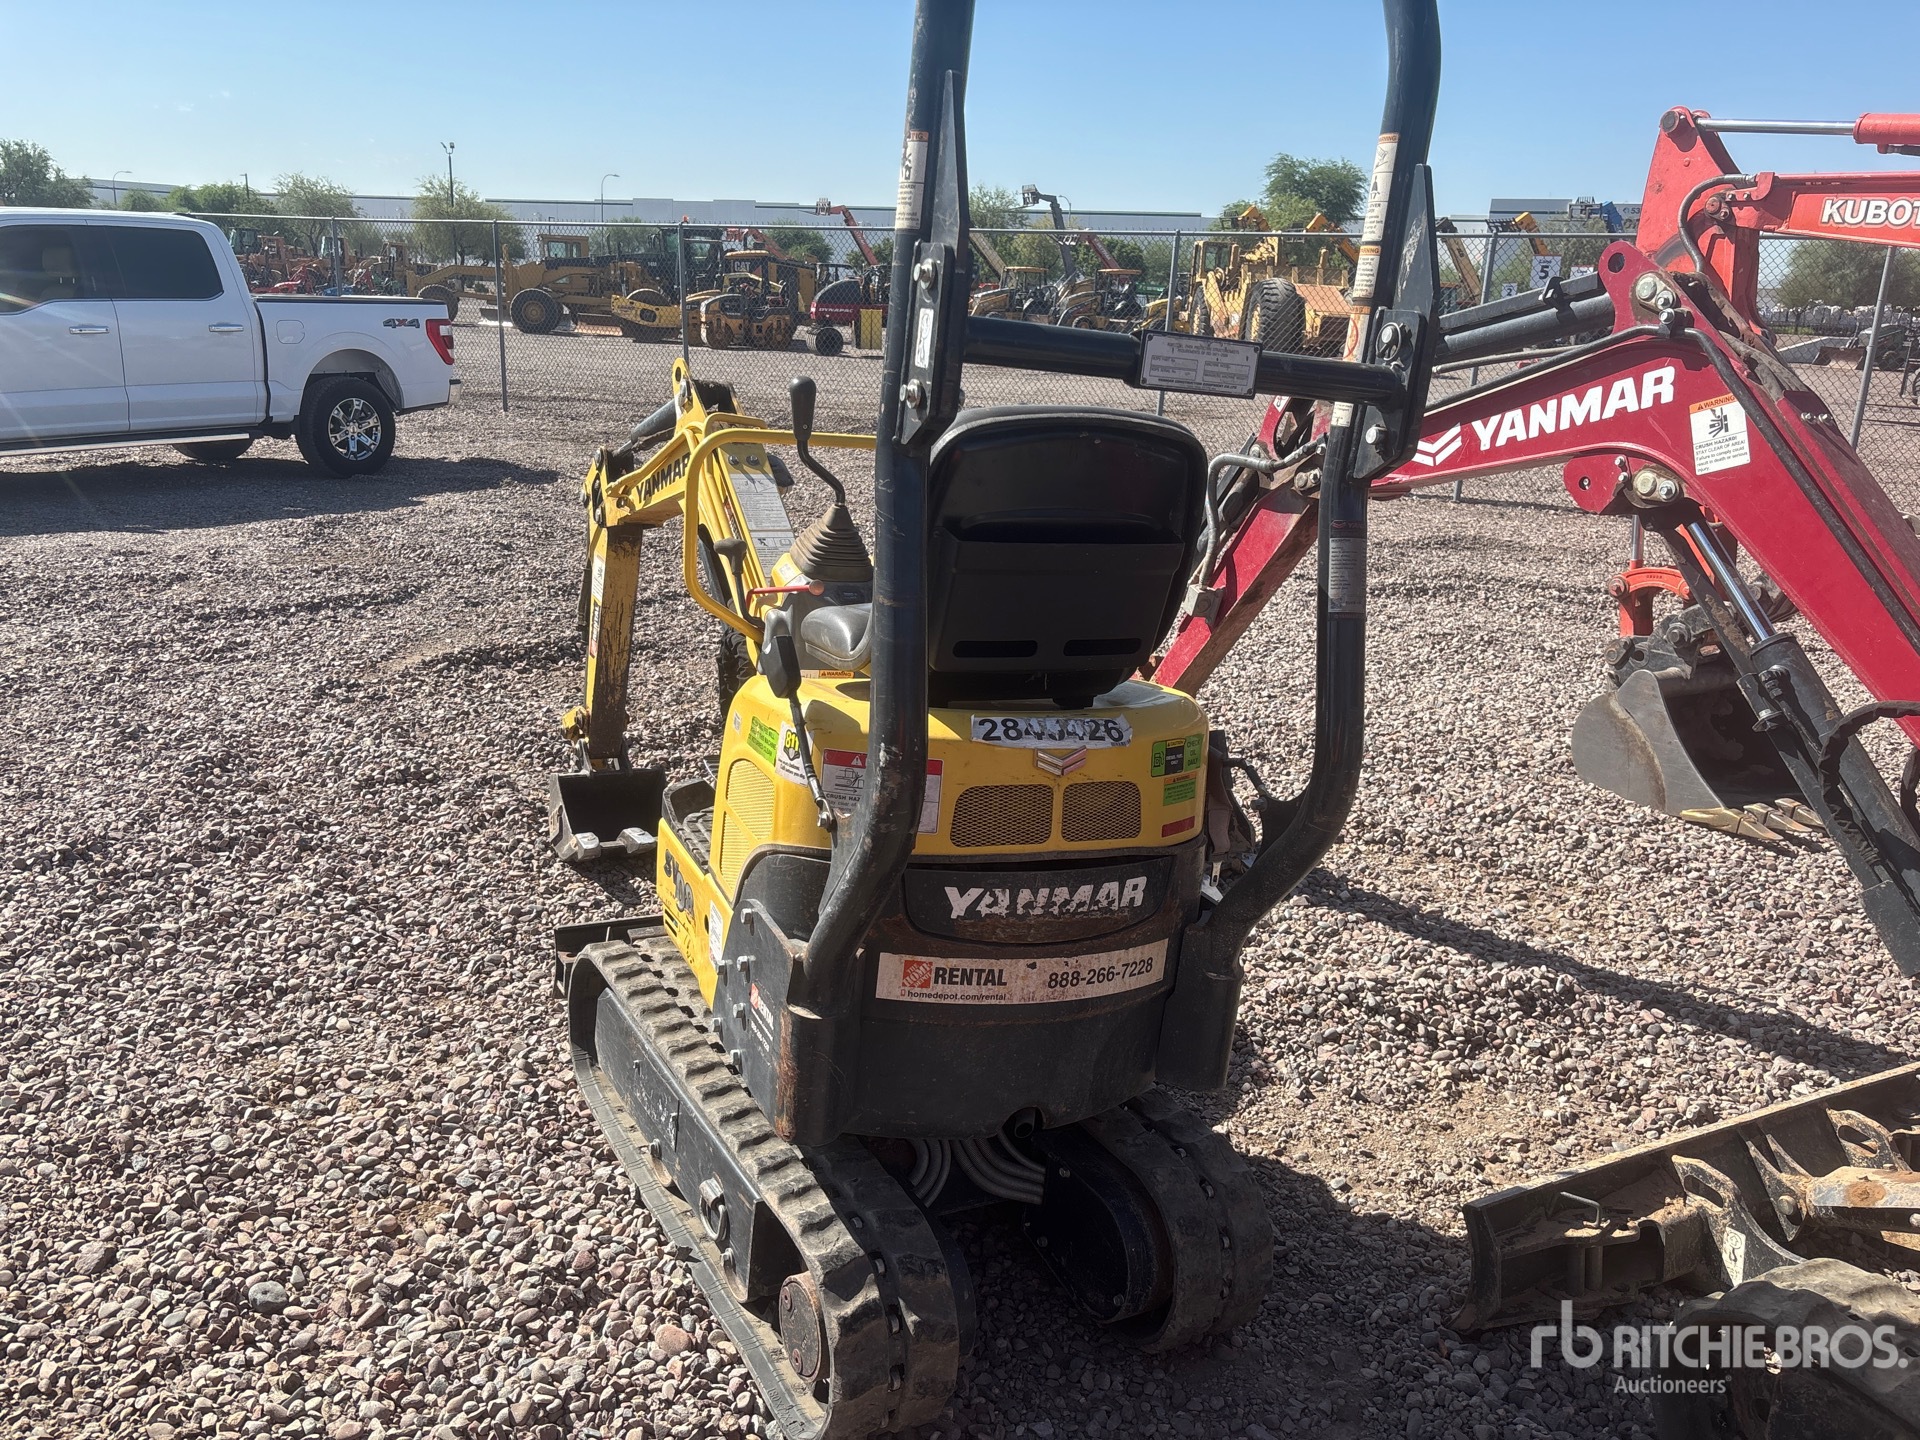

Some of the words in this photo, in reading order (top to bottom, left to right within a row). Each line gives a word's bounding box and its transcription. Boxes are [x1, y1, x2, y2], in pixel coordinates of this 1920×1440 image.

[734, 261, 751, 272] CAT
[1538, 264, 1550, 280] 5
[1506, 288, 1513, 297] 2
[1704, 395, 1736, 408] WARNING
[1470, 365, 1676, 452] YANMAR
[1695, 442, 1713, 450] CRUSH
[1714, 436, 1738, 446] HAZARD!
[1696, 448, 1707, 456] STAY
[1708, 445, 1724, 453] CLEAR
[785, 730, 799, 752] 811
[1186, 738, 1201, 748] CHECK
[826, 793, 847, 801] CRUSH
[944, 875, 1148, 919] YANMAR
[933, 966, 1008, 986] RENTAL
[1047, 956, 1154, 989] 888-266-7228
[907, 989, 1007, 1001] homedepot.com/rental
